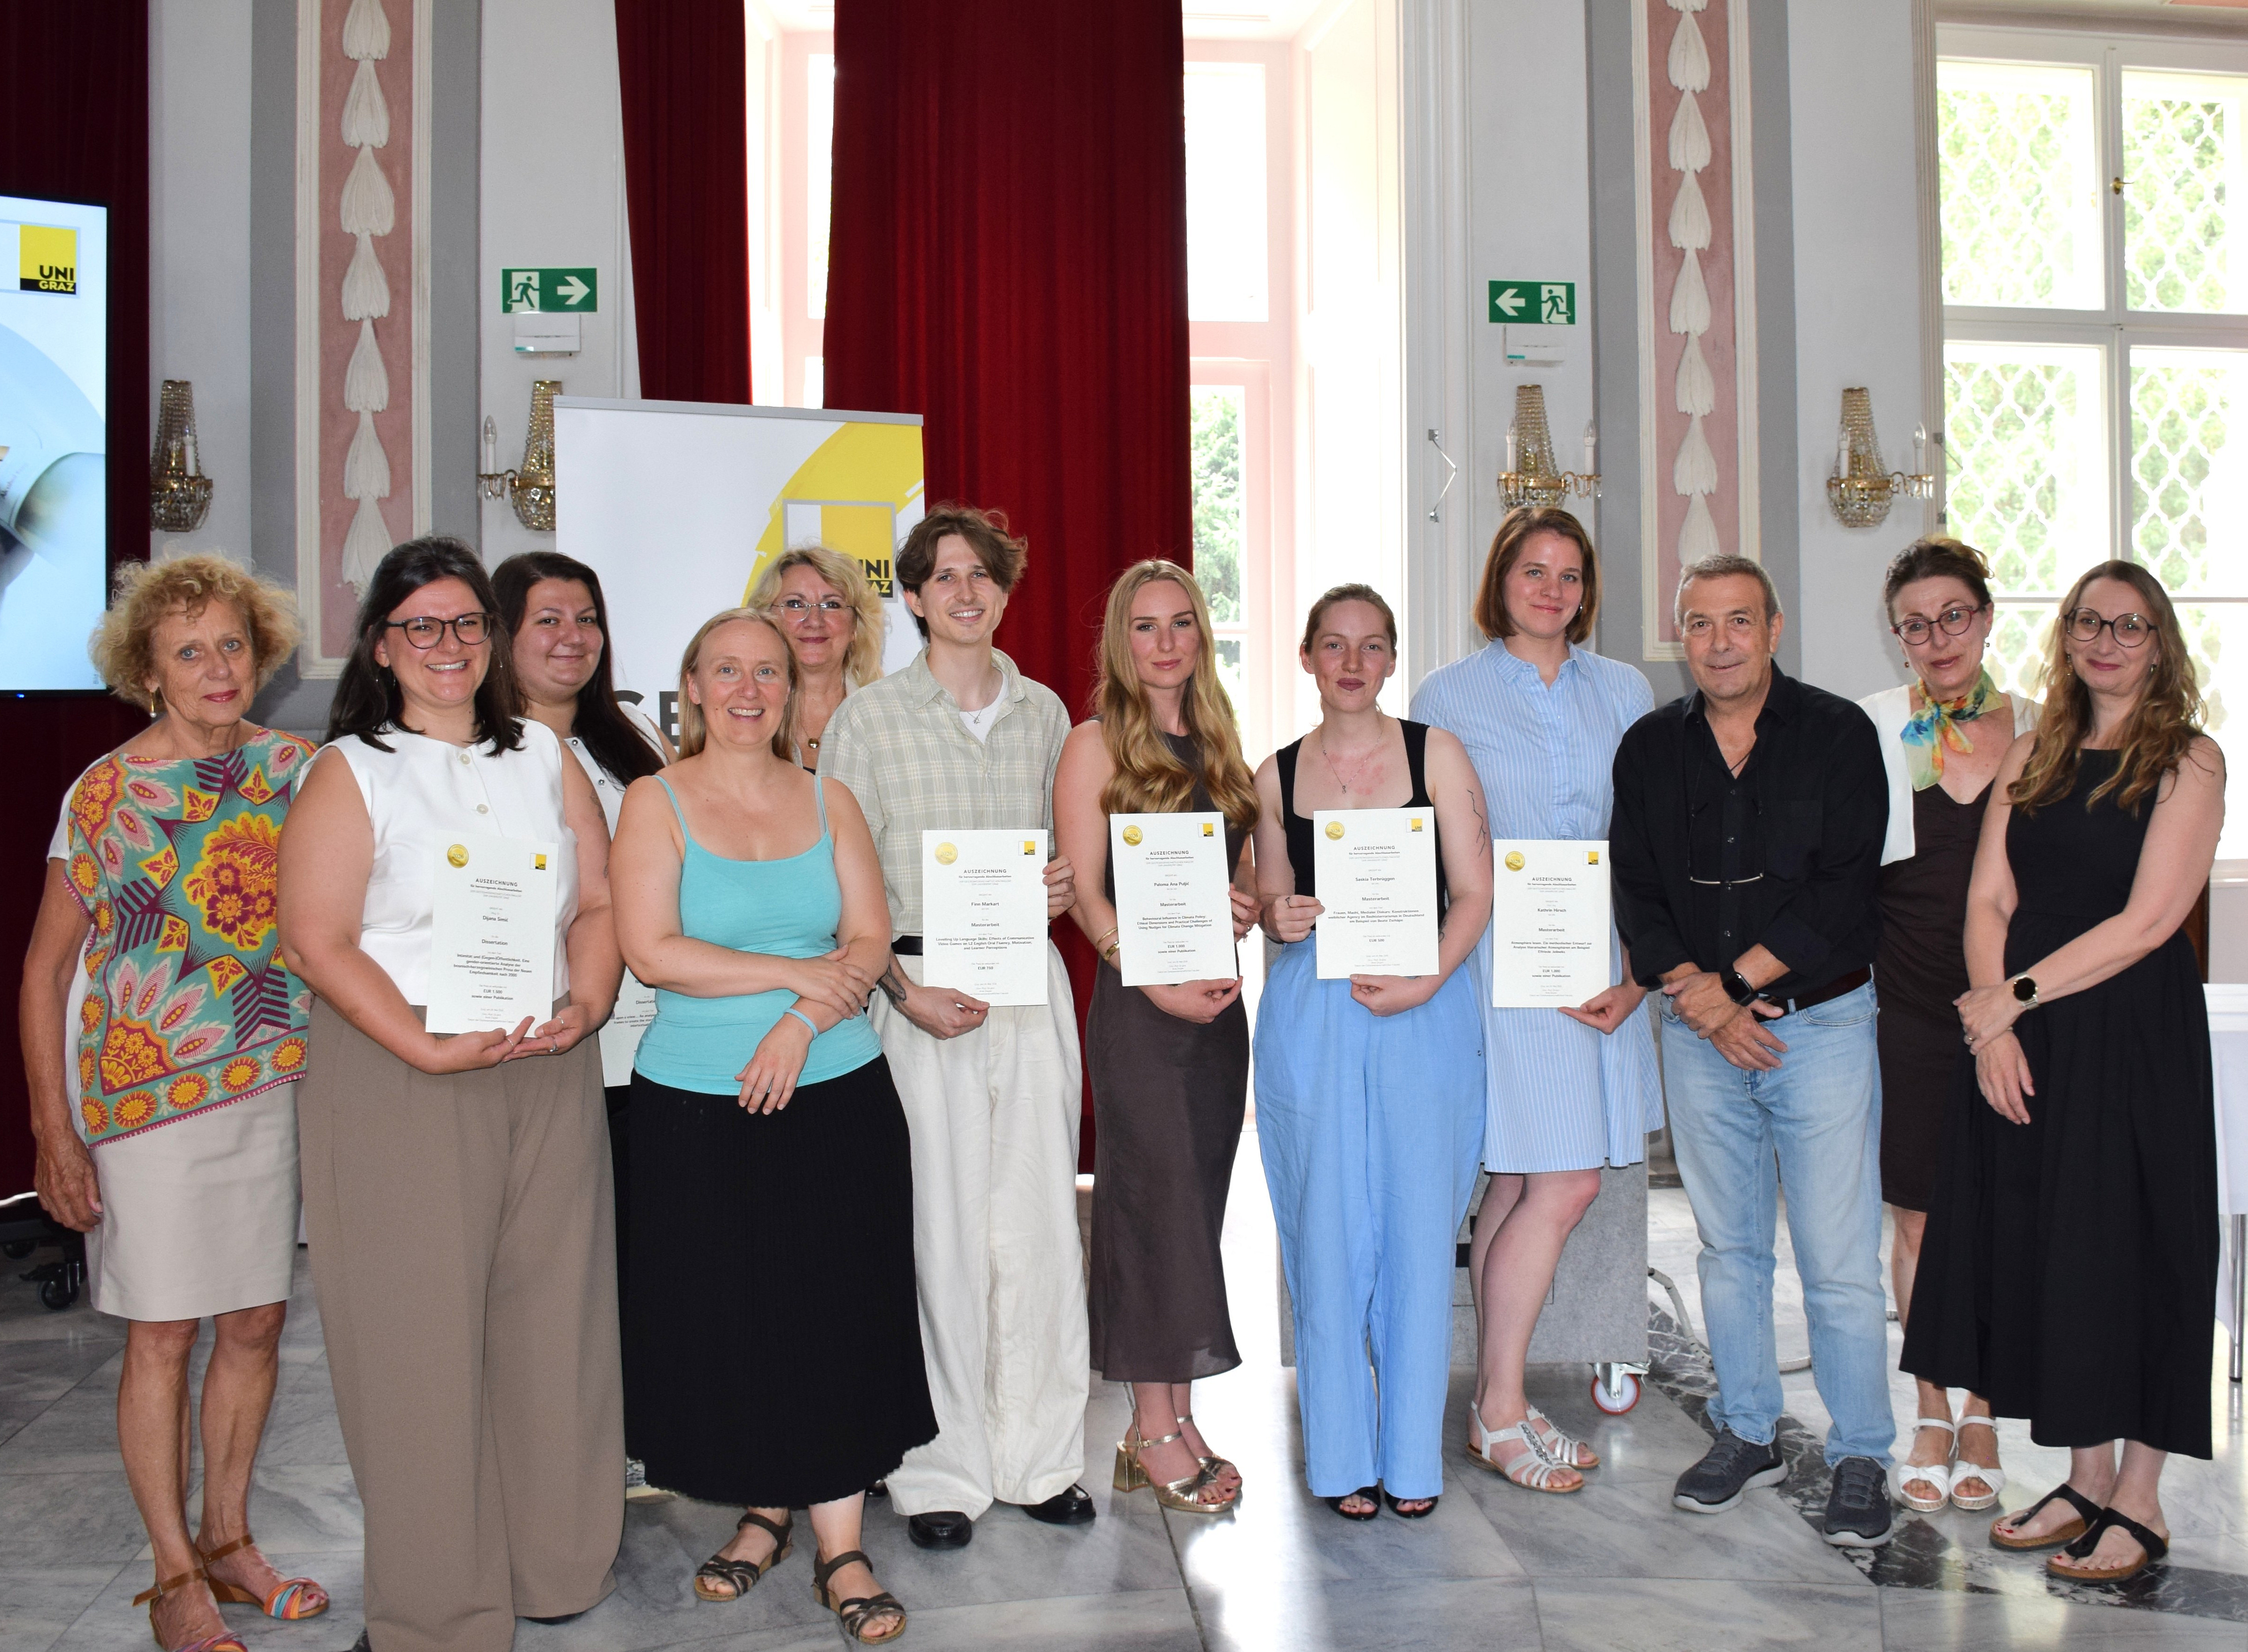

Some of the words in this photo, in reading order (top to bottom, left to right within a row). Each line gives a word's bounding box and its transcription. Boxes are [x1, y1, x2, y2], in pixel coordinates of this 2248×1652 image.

[39, 265, 74, 281] UNI
[39, 281, 74, 291] GRAZ
[858, 559, 889, 579] NI
[476, 878, 518, 887] AUSZEICHNUNG
